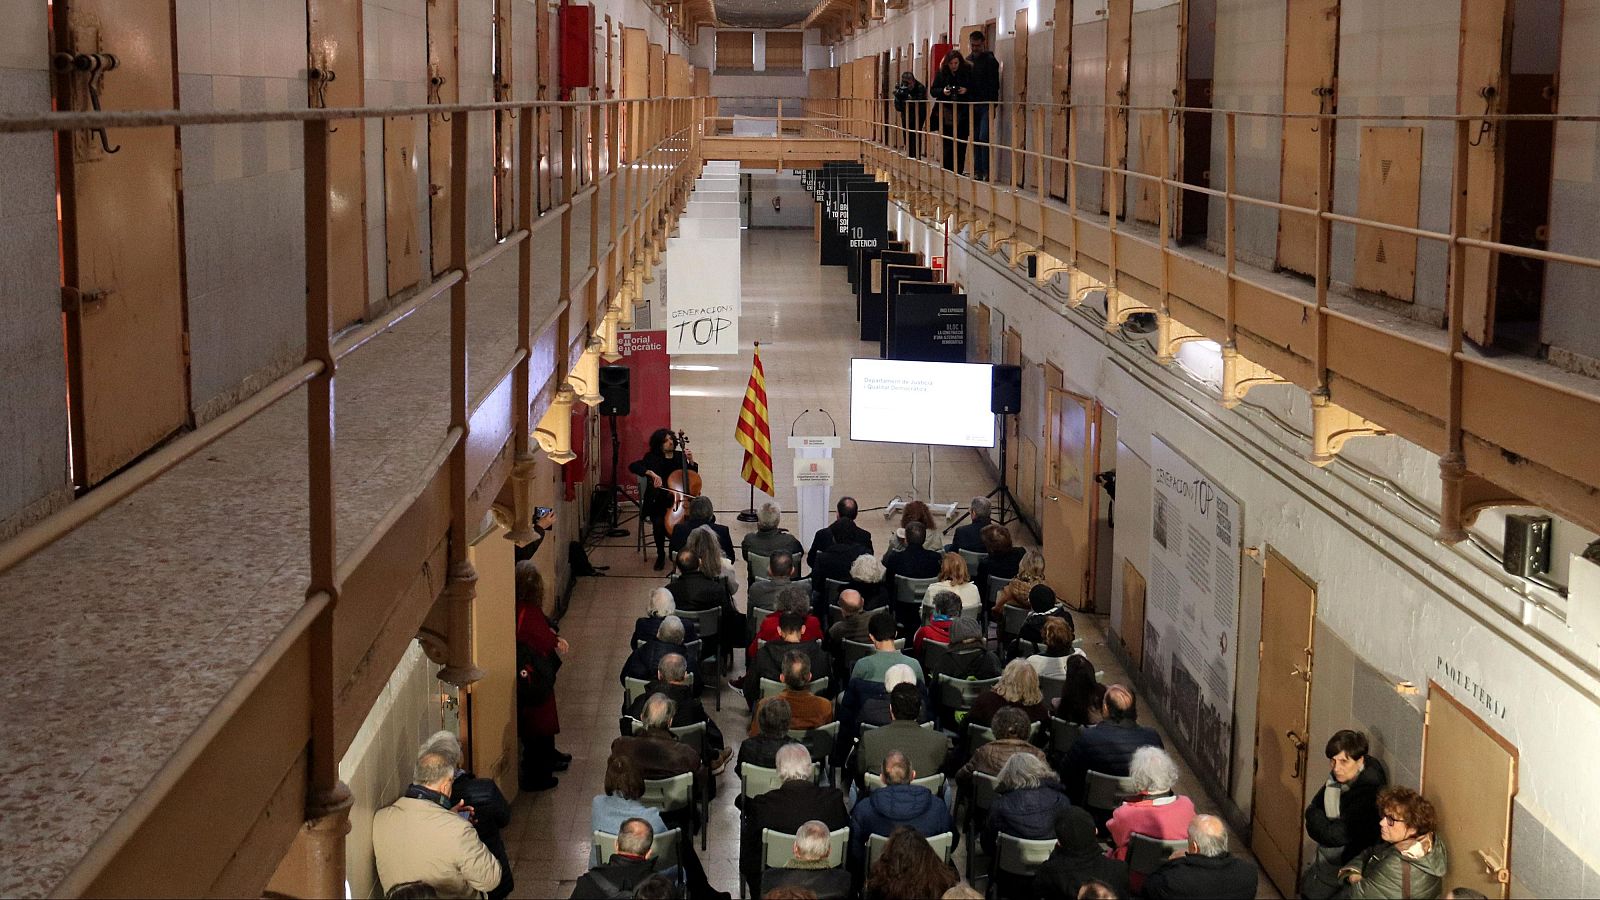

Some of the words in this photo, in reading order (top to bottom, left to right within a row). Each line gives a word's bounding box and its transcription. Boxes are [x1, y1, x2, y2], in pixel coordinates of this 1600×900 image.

[851, 227, 863, 239] 10
[850, 238, 877, 248] DETENCIÓ
[672, 305, 733, 318] GENERACIONS
[673, 318, 731, 349] TOP
[617, 335, 650, 345] emorial
[617, 343, 662, 353] emocràtic
[1193, 478, 1214, 520] TOP
